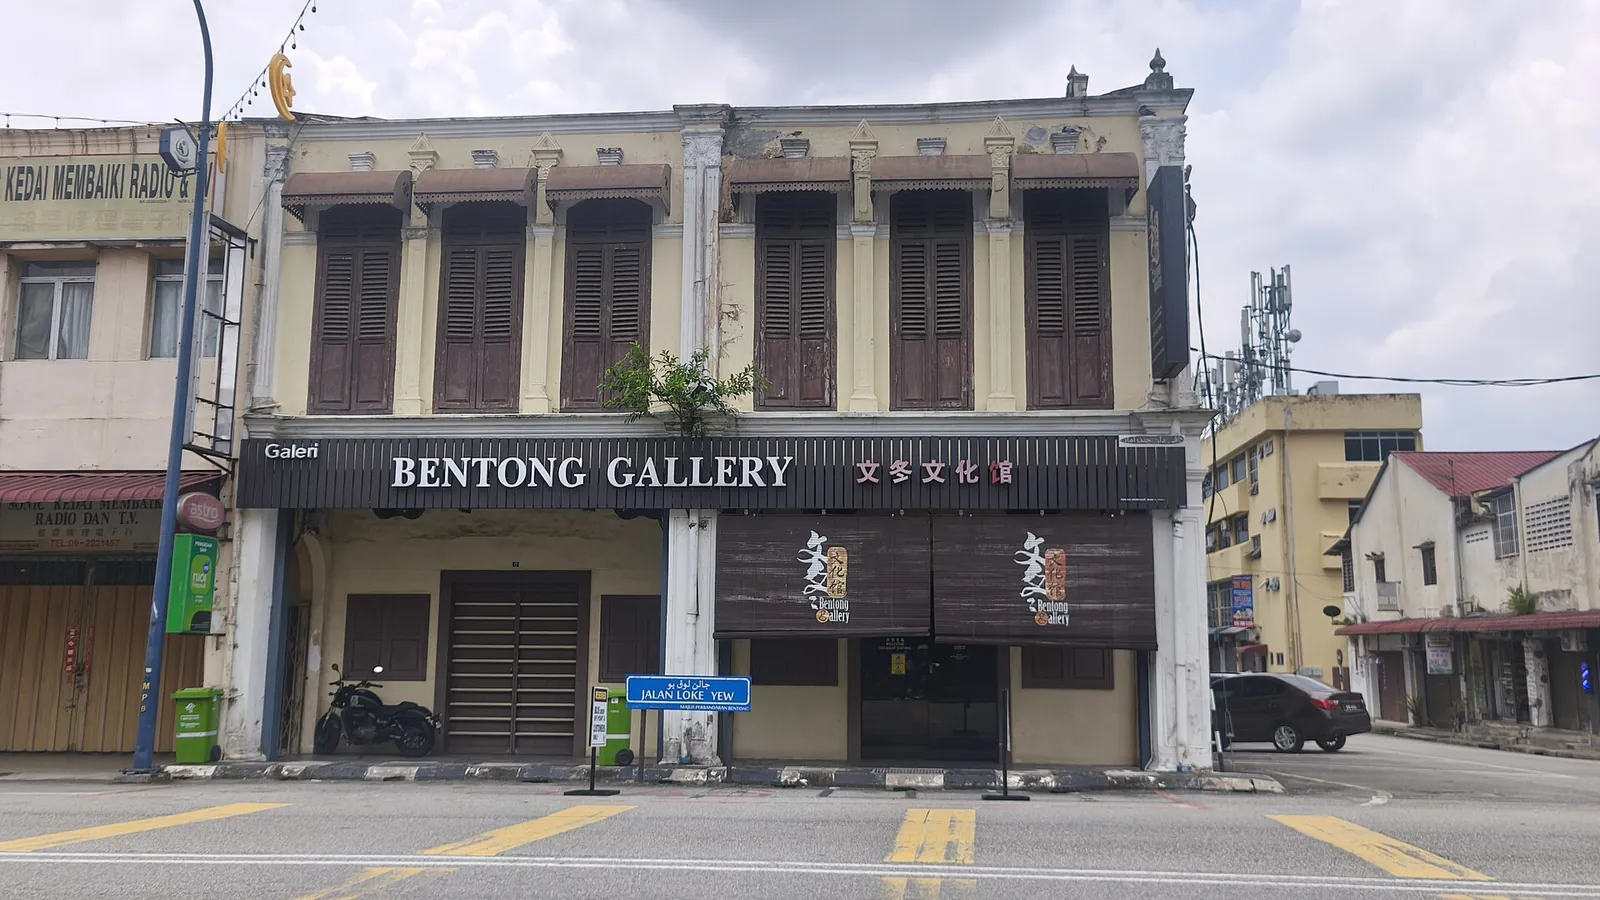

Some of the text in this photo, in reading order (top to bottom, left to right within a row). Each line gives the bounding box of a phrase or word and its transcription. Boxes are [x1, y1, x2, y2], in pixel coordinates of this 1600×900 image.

[5, 165, 49, 201] KEDAI
[52, 163, 126, 200] MEMBAIKI
[129, 163, 175, 198] RADIO
[264, 442, 319, 460] Galeri
[391, 456, 794, 488] BENTONG GALLERY
[856, 459, 1013, 484] 文冬文化馆
[99, 498, 163, 510] MEMBAIK
[189, 502, 219, 519] astro
[35, 511, 139, 525] RADIO DAN T.V.
[819, 597, 849, 611] Bentong
[1037, 599, 1069, 613] Bentong
[641, 689, 735, 701] JALAN LOKE YEW
